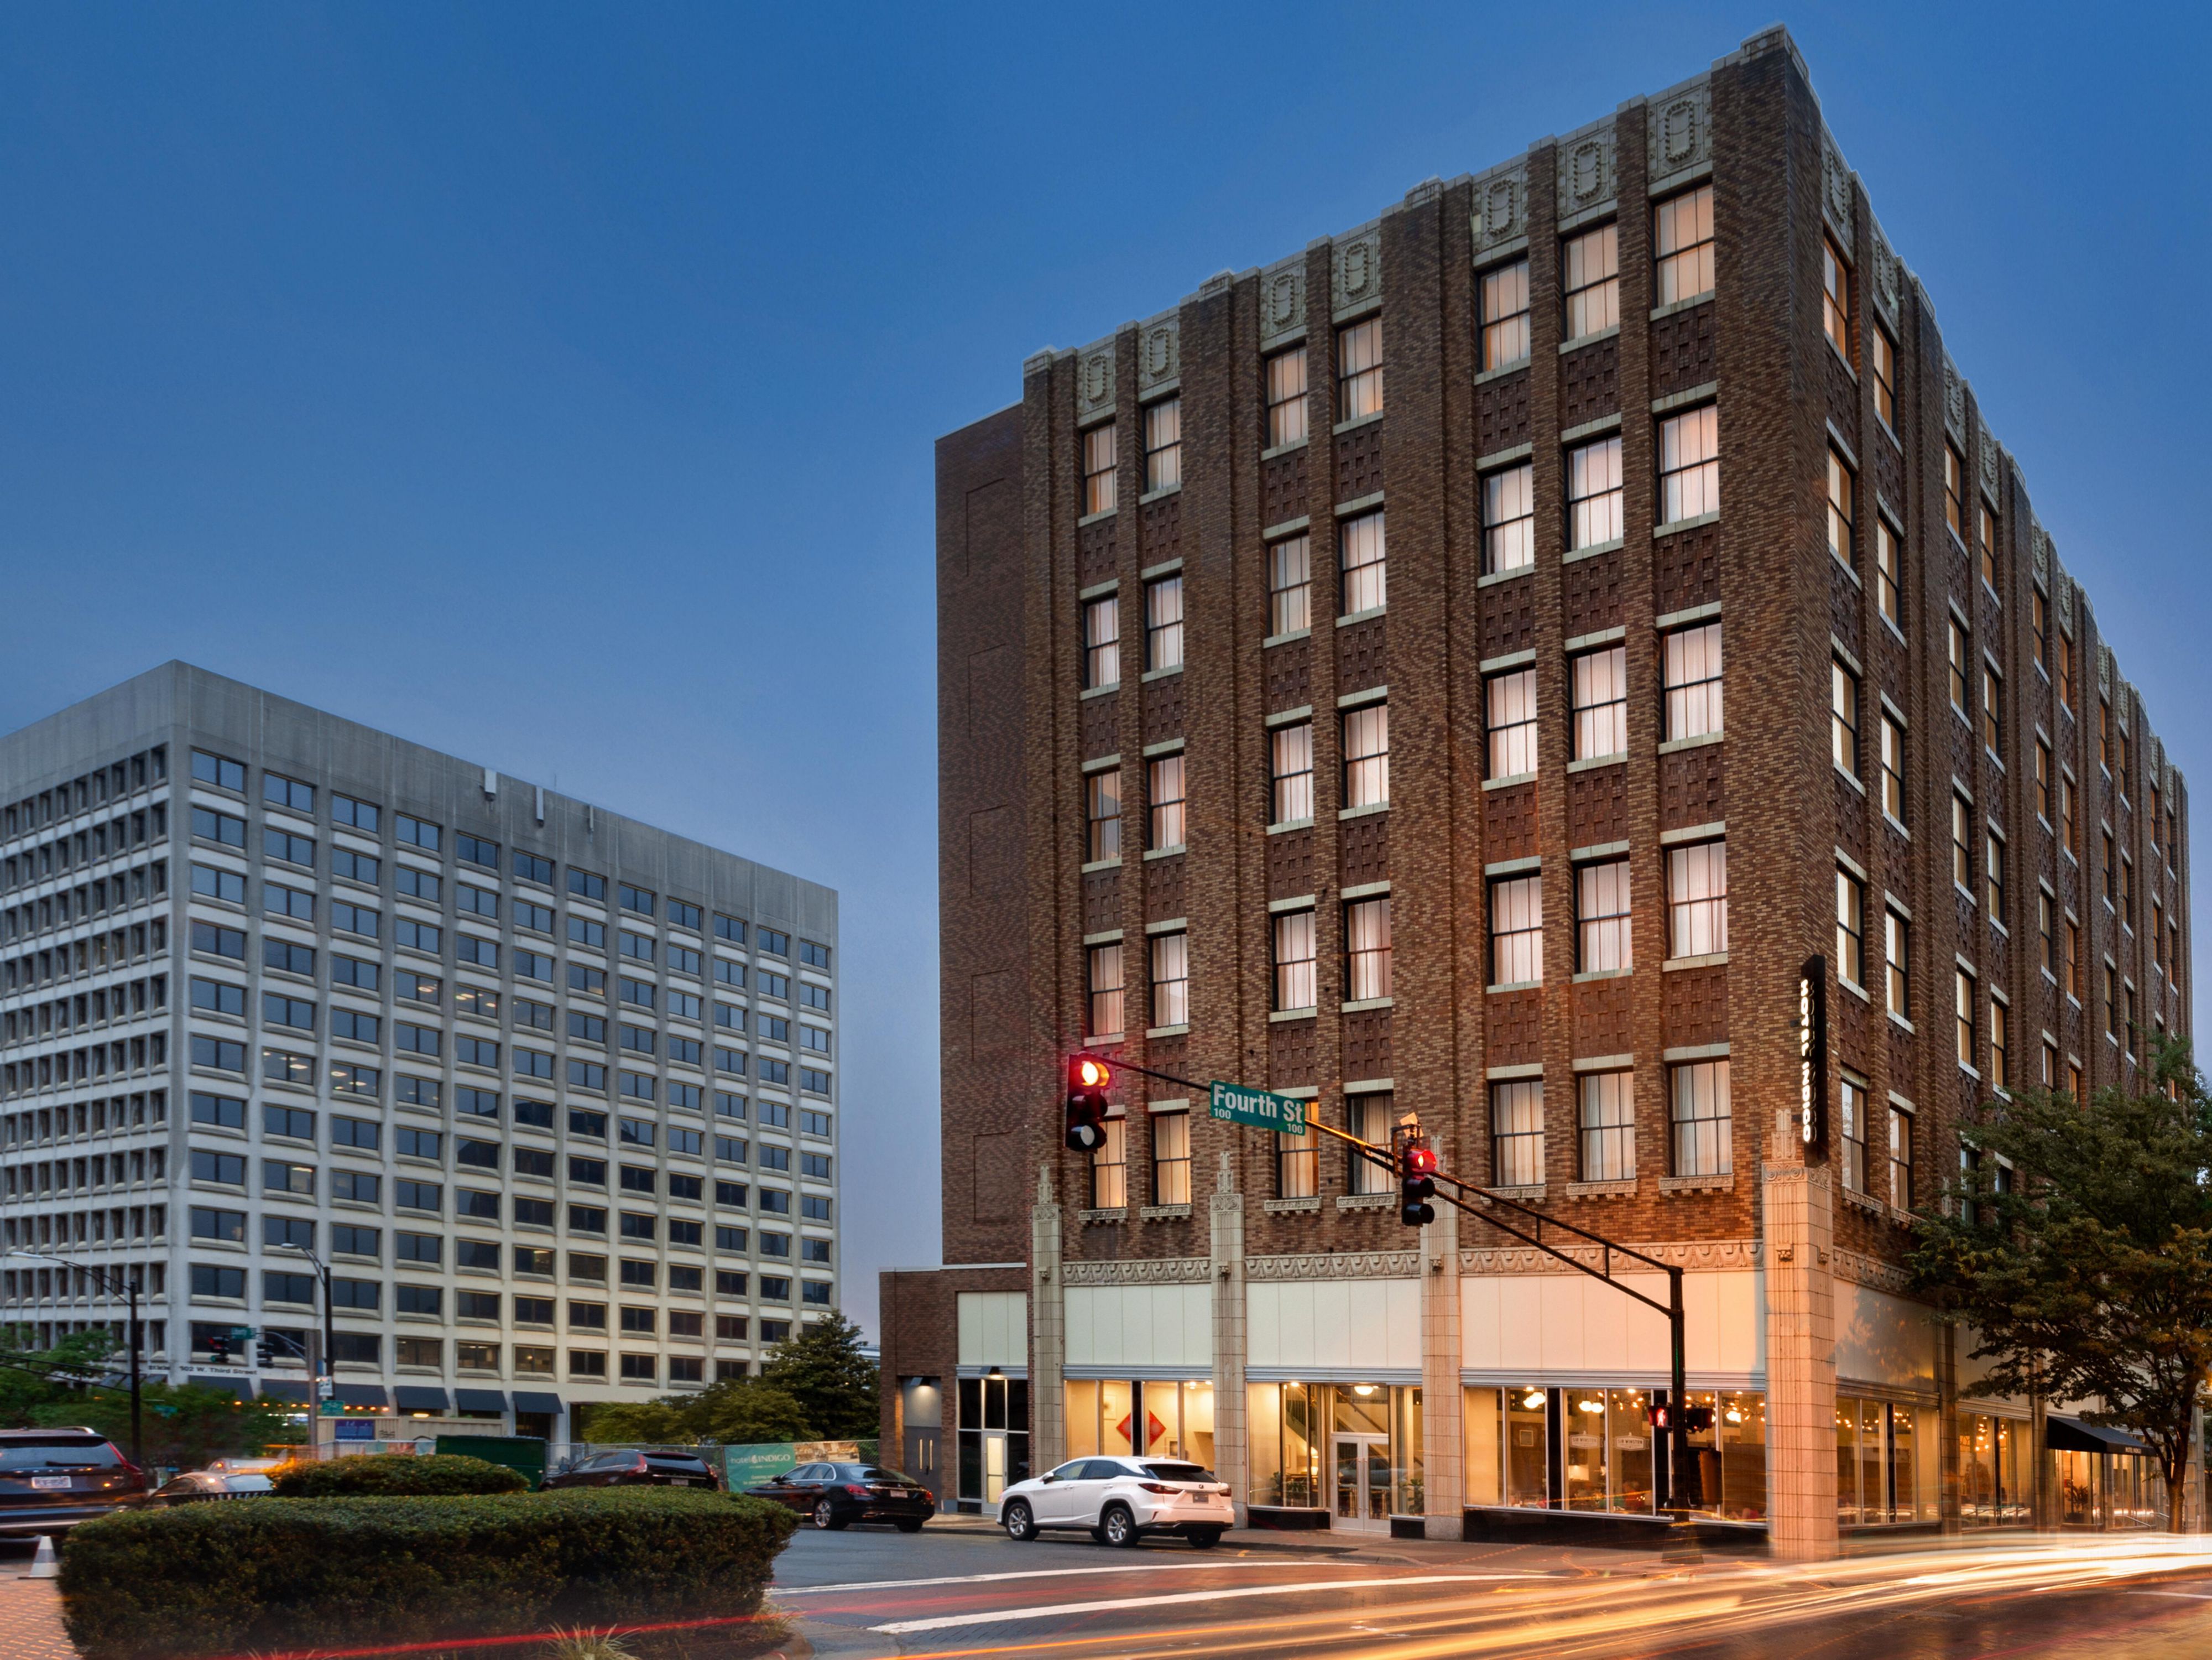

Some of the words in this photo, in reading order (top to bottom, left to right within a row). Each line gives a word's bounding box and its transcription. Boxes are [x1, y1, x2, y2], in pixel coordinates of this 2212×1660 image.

[1214, 1084, 1277, 1118] Fourth
[1283, 1100, 1302, 1123] St
[1214, 1108, 1232, 1119] 100
[1287, 1123, 1303, 1134] 100
[758, 1454, 790, 1463] INDIGO
